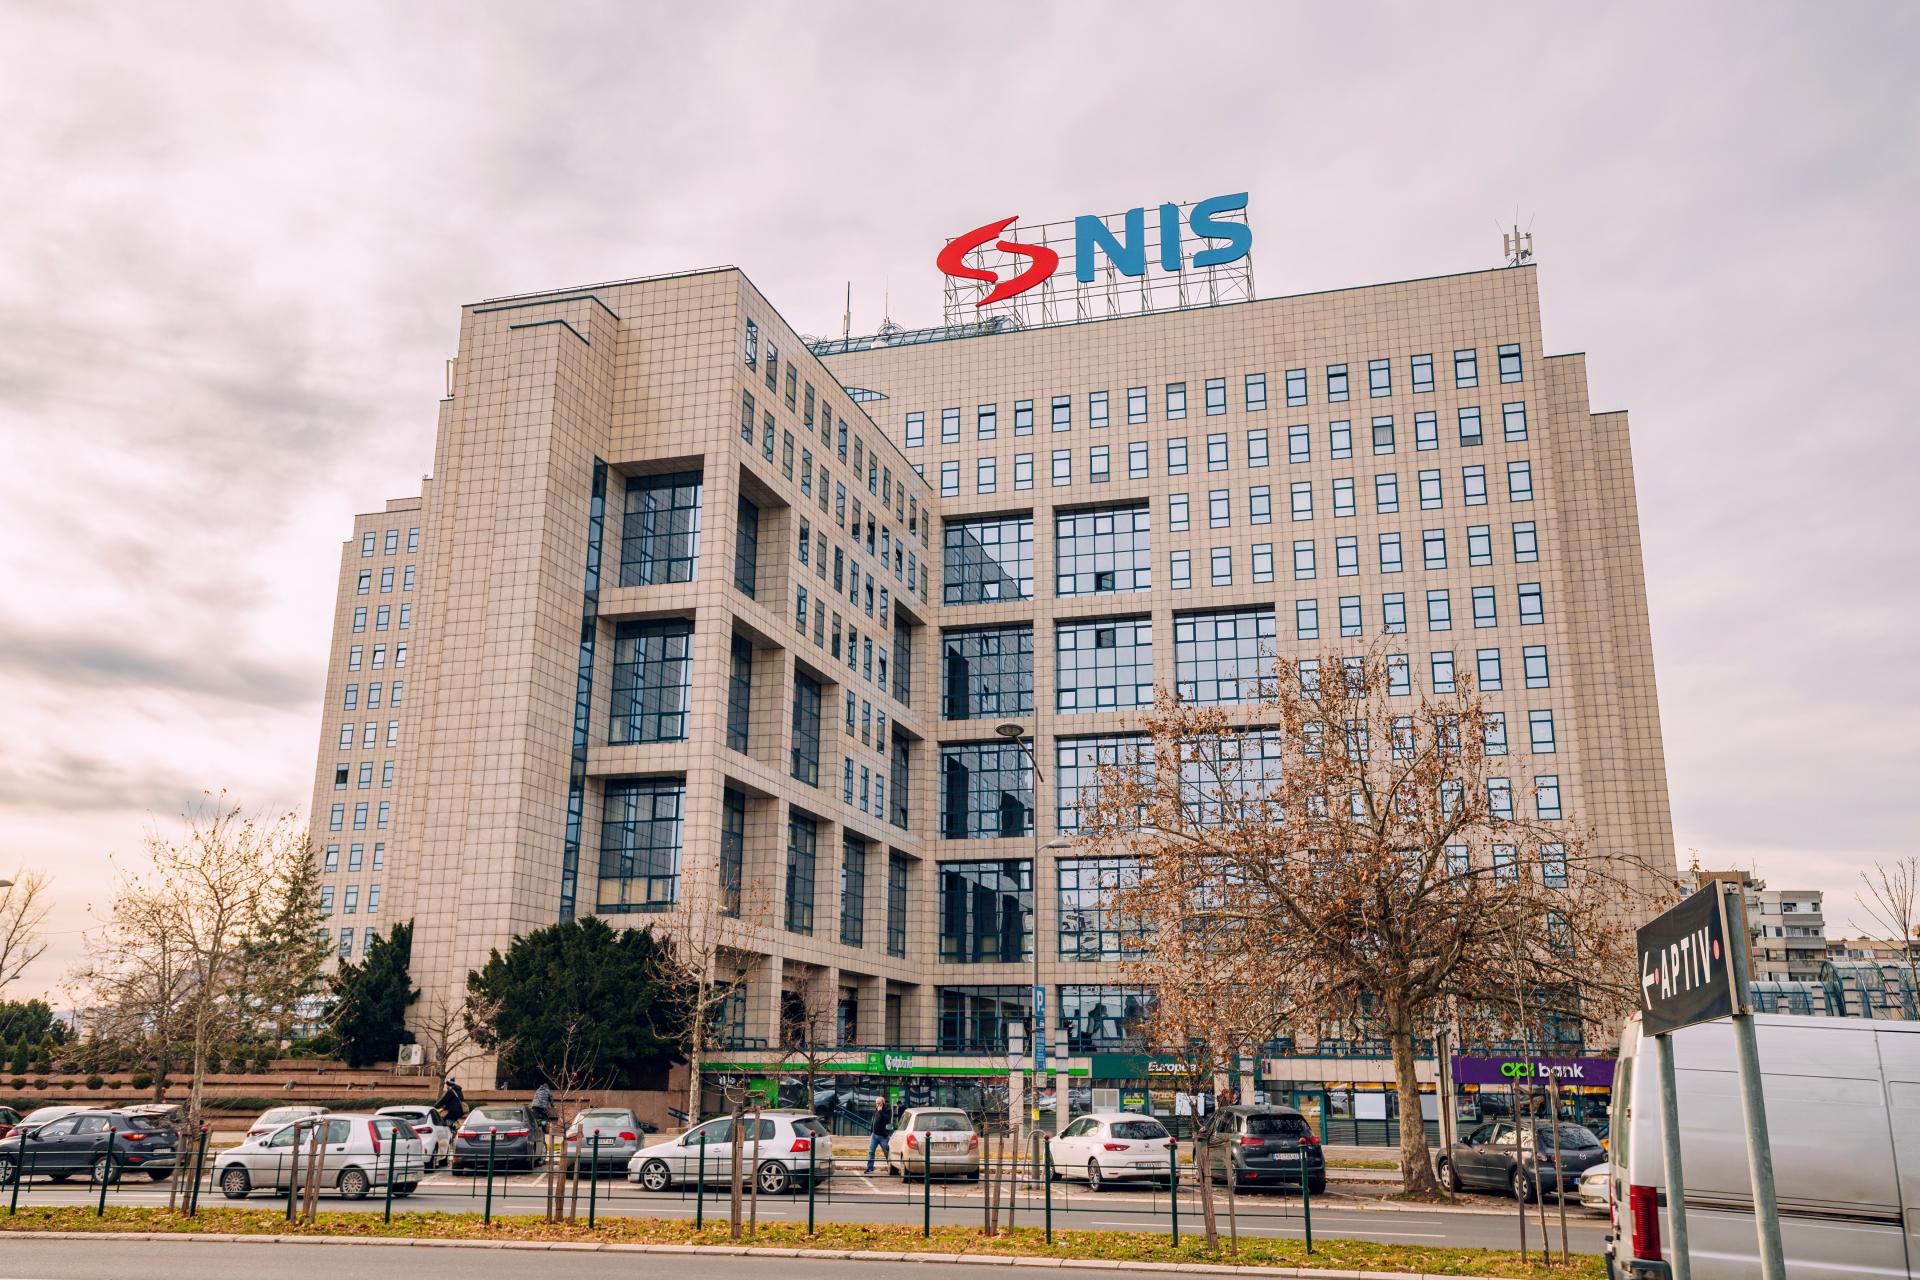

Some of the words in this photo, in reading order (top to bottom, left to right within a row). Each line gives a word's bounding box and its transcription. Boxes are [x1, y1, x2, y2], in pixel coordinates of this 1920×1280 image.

[1075, 191, 1252, 282] NIS
[1661, 926, 1711, 1000] APTIV
[1148, 1061, 1201, 1076] Europca
[1501, 1062, 1535, 1078] api
[1538, 1062, 1584, 1078] bank
